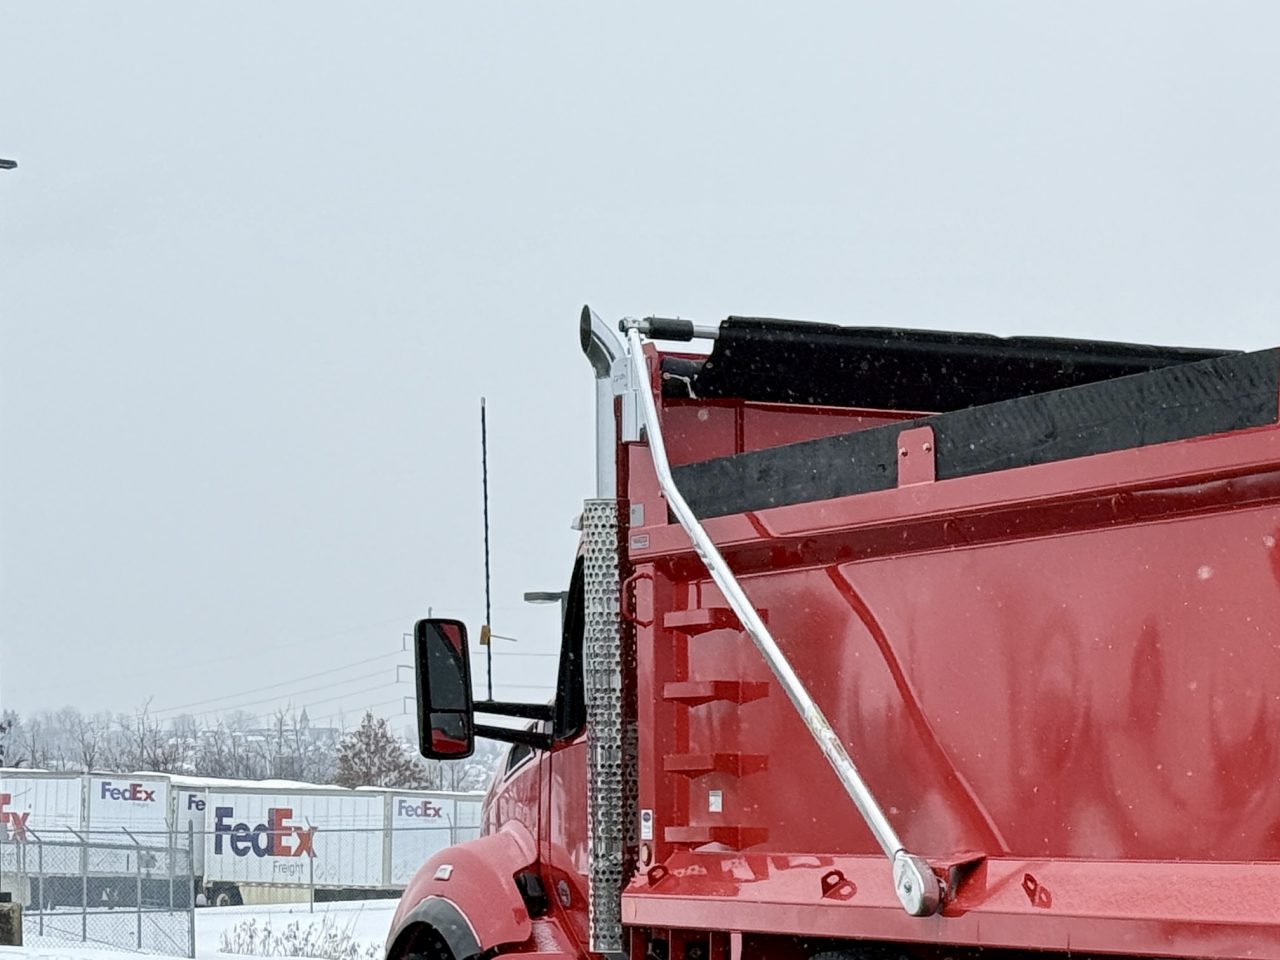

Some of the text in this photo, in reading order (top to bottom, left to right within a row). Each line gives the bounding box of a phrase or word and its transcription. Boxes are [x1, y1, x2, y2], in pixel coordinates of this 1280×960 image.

[100, 782, 156, 802] FedEx
[398, 799, 443, 818] FedEx
[214, 807, 318, 858] FedEx
[272, 861, 304, 876] Freight
